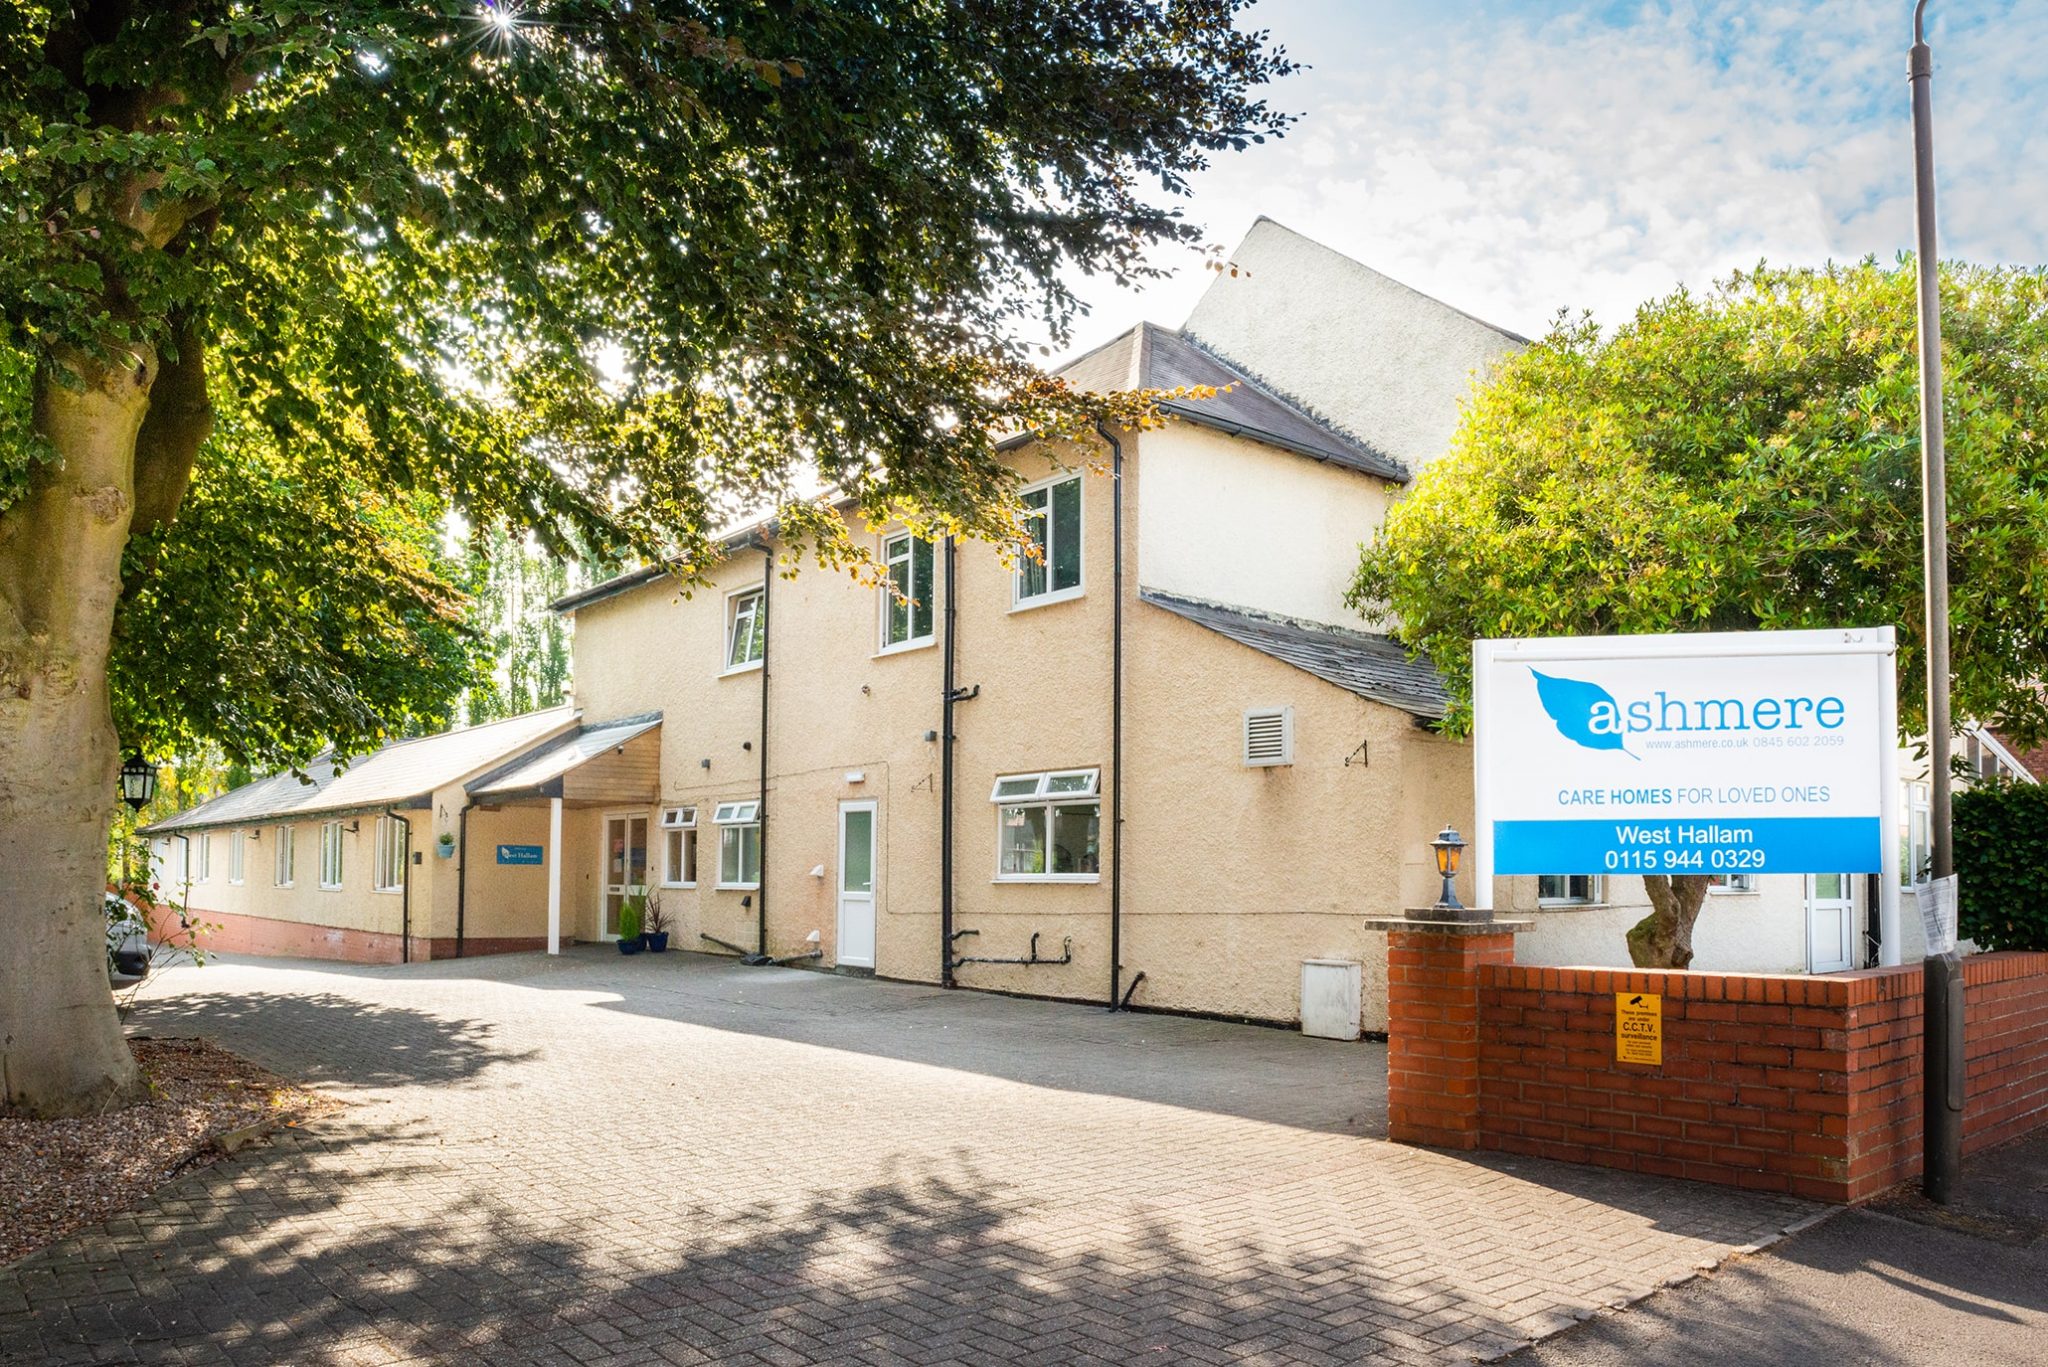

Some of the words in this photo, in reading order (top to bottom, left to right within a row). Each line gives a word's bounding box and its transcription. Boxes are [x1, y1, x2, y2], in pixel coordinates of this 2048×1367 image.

[1588, 692, 1845, 735] ashmere
[1645, 738, 1749, 750] www.ashmere.co.uk
[1753, 737, 1783, 748] 0845
[1787, 736, 1809, 747] 602
[1814, 735, 1844, 747] 2059
[1558, 789, 1605, 805] CARE
[1610, 788, 1672, 805] HOMES
[1677, 787, 1713, 804] FOR
[1718, 786, 1777, 804] LOVED
[1781, 786, 1830, 803] ONES
[1615, 825, 1672, 845] West
[1677, 824, 1753, 844] Hallam
[1605, 850, 1657, 869] 0115
[1663, 849, 1704, 869] 944
[1710, 849, 1765, 868] 0329
